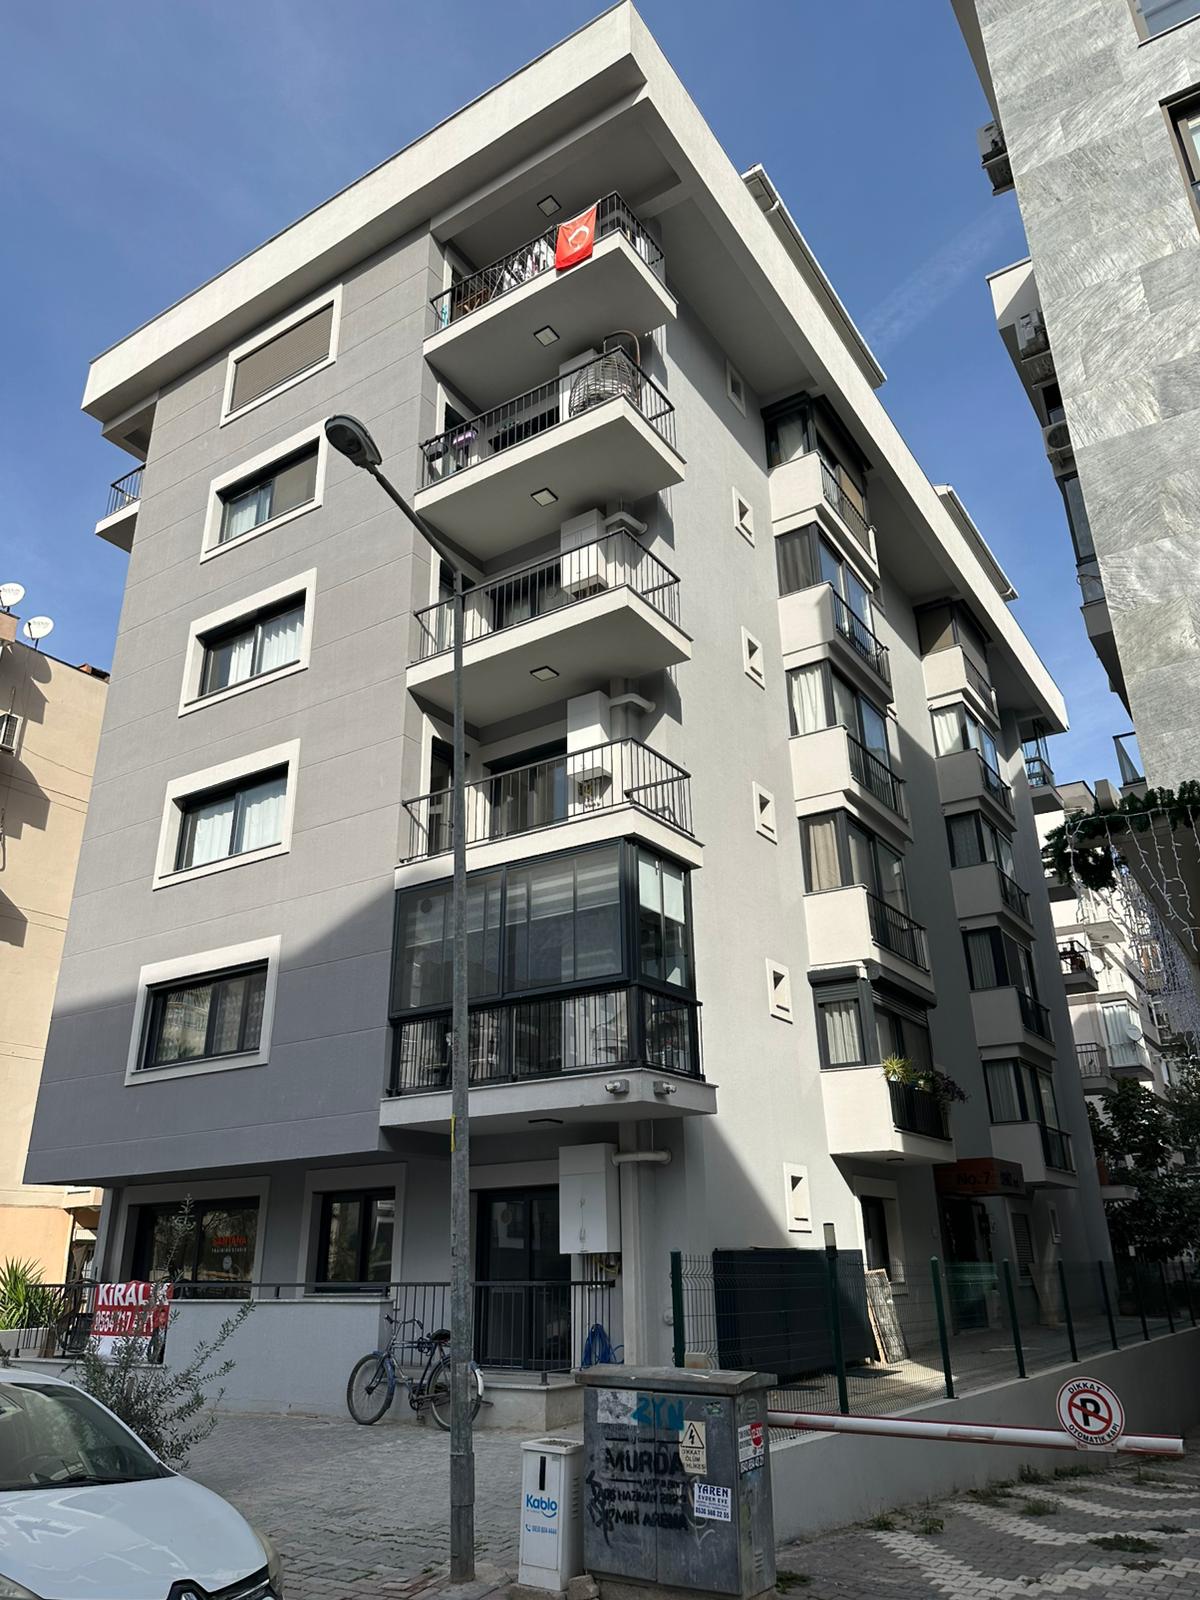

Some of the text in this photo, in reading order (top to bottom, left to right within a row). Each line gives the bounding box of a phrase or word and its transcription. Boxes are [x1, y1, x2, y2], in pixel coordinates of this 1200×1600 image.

[1068, 1382, 1102, 1394] DİKKAT
[697, 1484, 728, 1498] YAREN
[526, 1494, 558, 1511] Kablo
